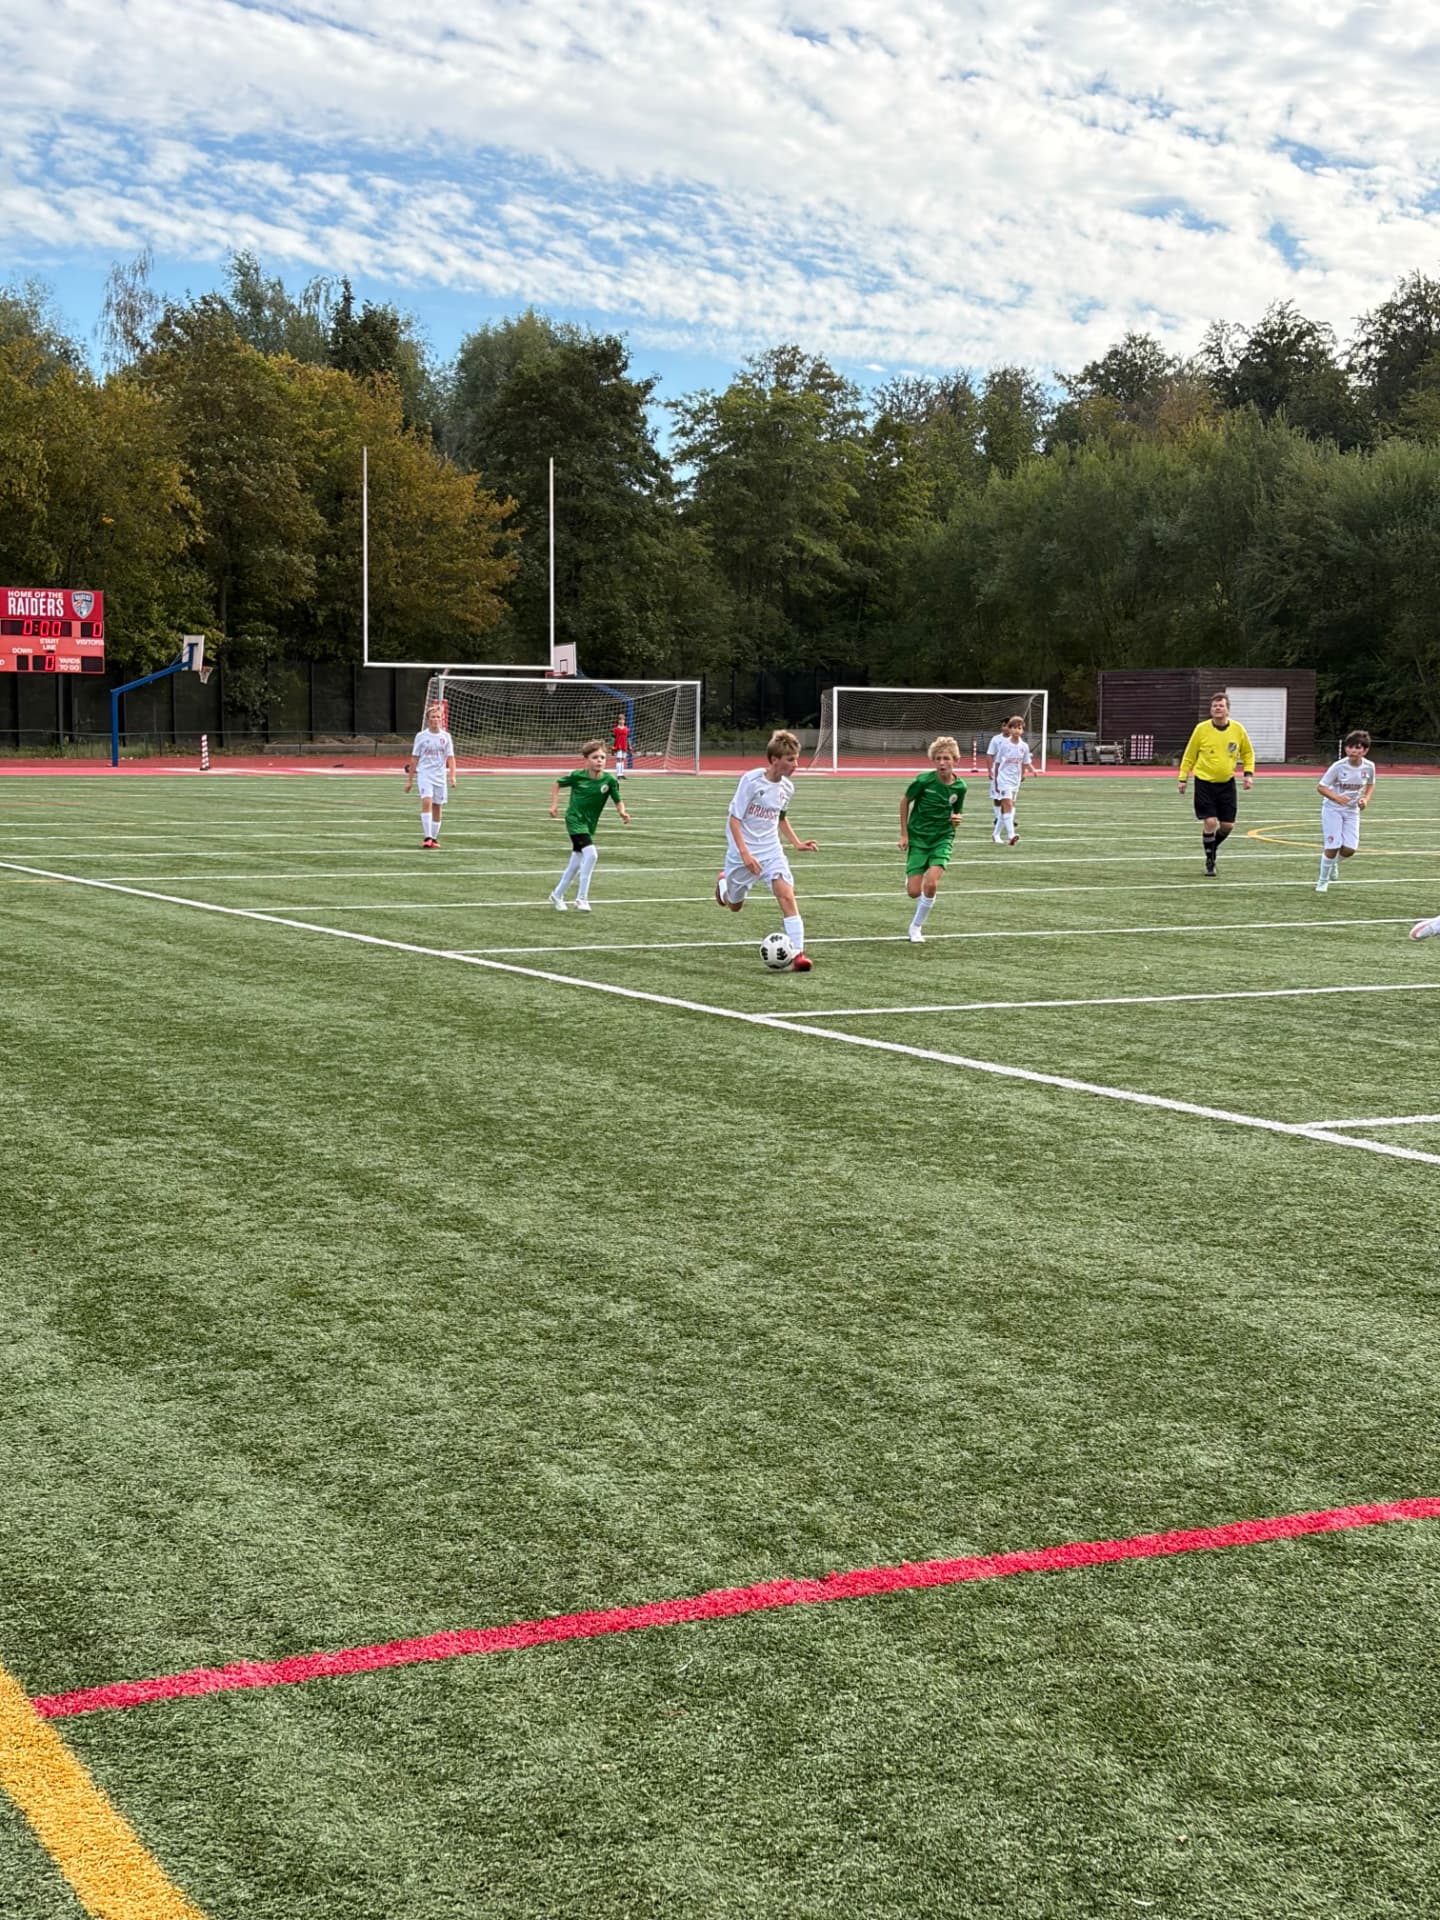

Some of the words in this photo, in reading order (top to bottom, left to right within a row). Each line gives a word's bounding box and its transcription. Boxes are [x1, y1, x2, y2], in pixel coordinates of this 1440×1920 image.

[8, 598, 64, 616] RAIDERS
[23, 620, 61, 637] 0:00
[93, 622, 102, 637] 0
[45, 655, 55, 671] 0
